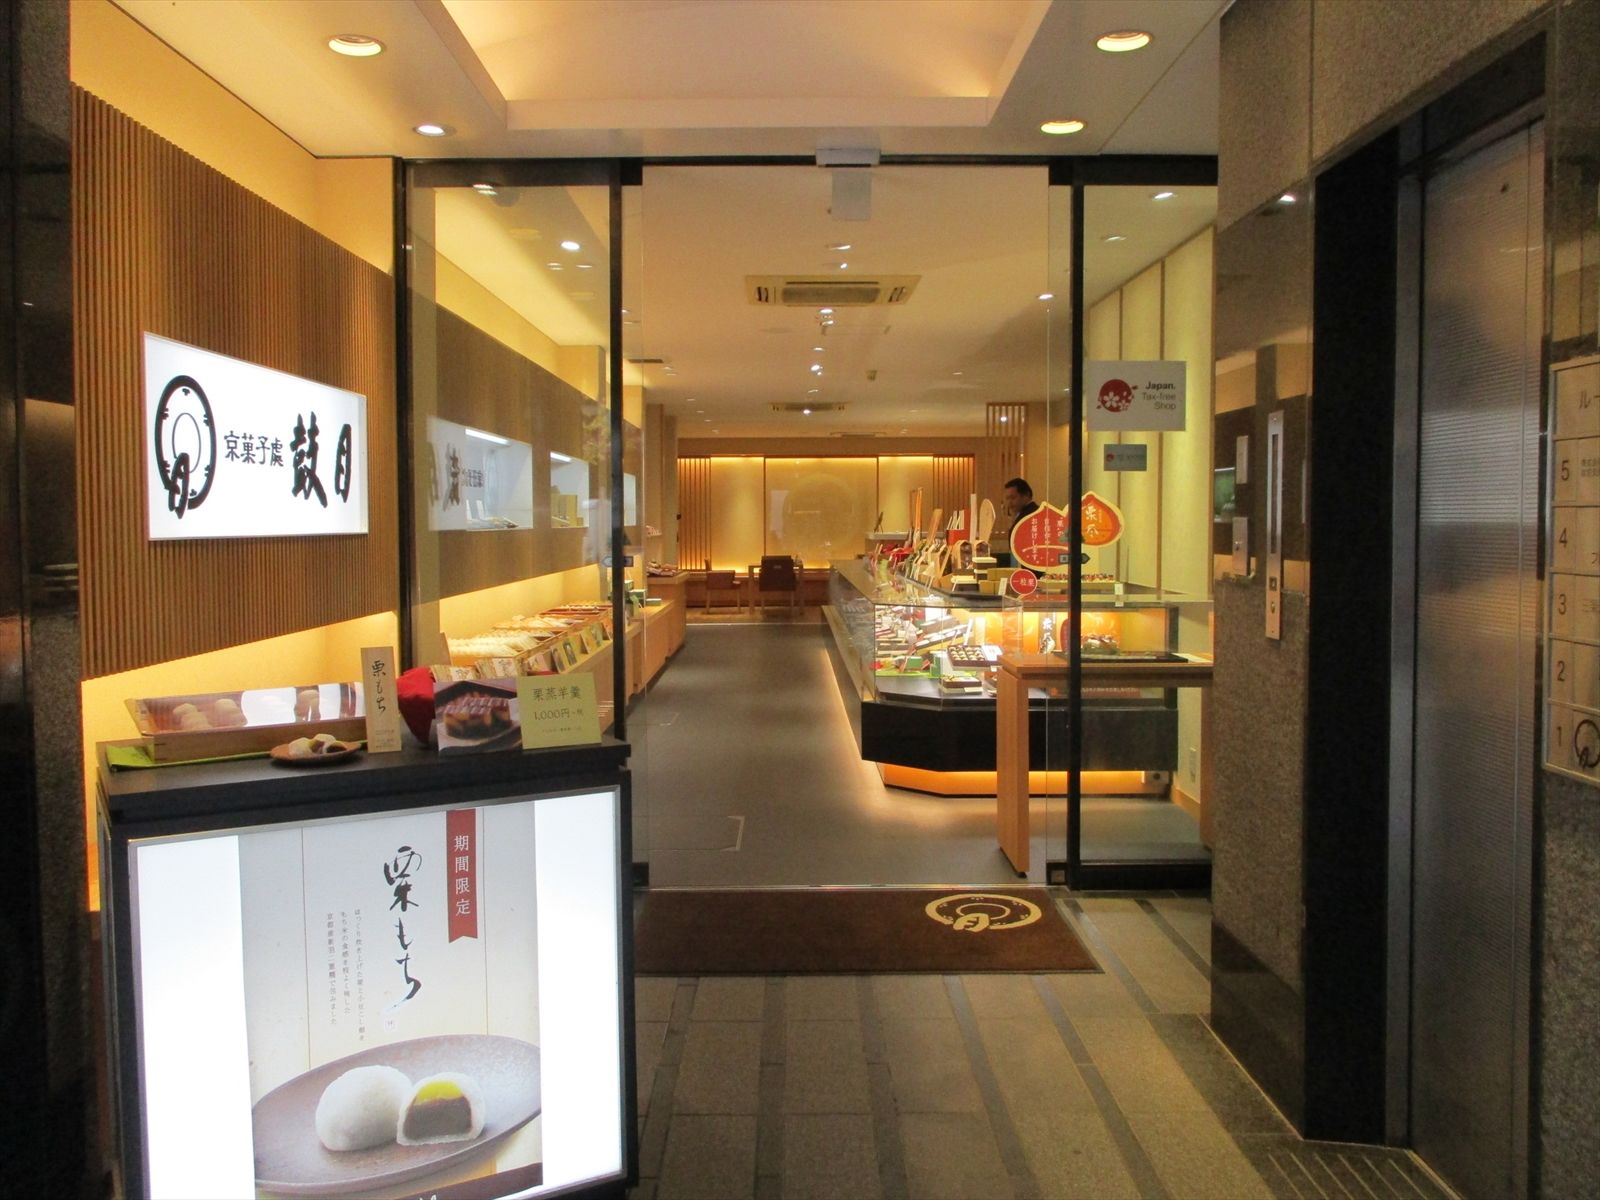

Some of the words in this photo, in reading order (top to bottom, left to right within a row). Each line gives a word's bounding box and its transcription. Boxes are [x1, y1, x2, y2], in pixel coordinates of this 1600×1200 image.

[1561, 460, 1569, 481] 5
[1559, 527, 1568, 548] 4
[1558, 593, 1567, 616] 3
[1557, 660, 1565, 682] 2
[371, 660, 387, 715] 栗もち
[1557, 726, 1563, 747] 1
[453, 835, 471, 916] 期間限定
[384, 845, 422, 1009] 栗もち
